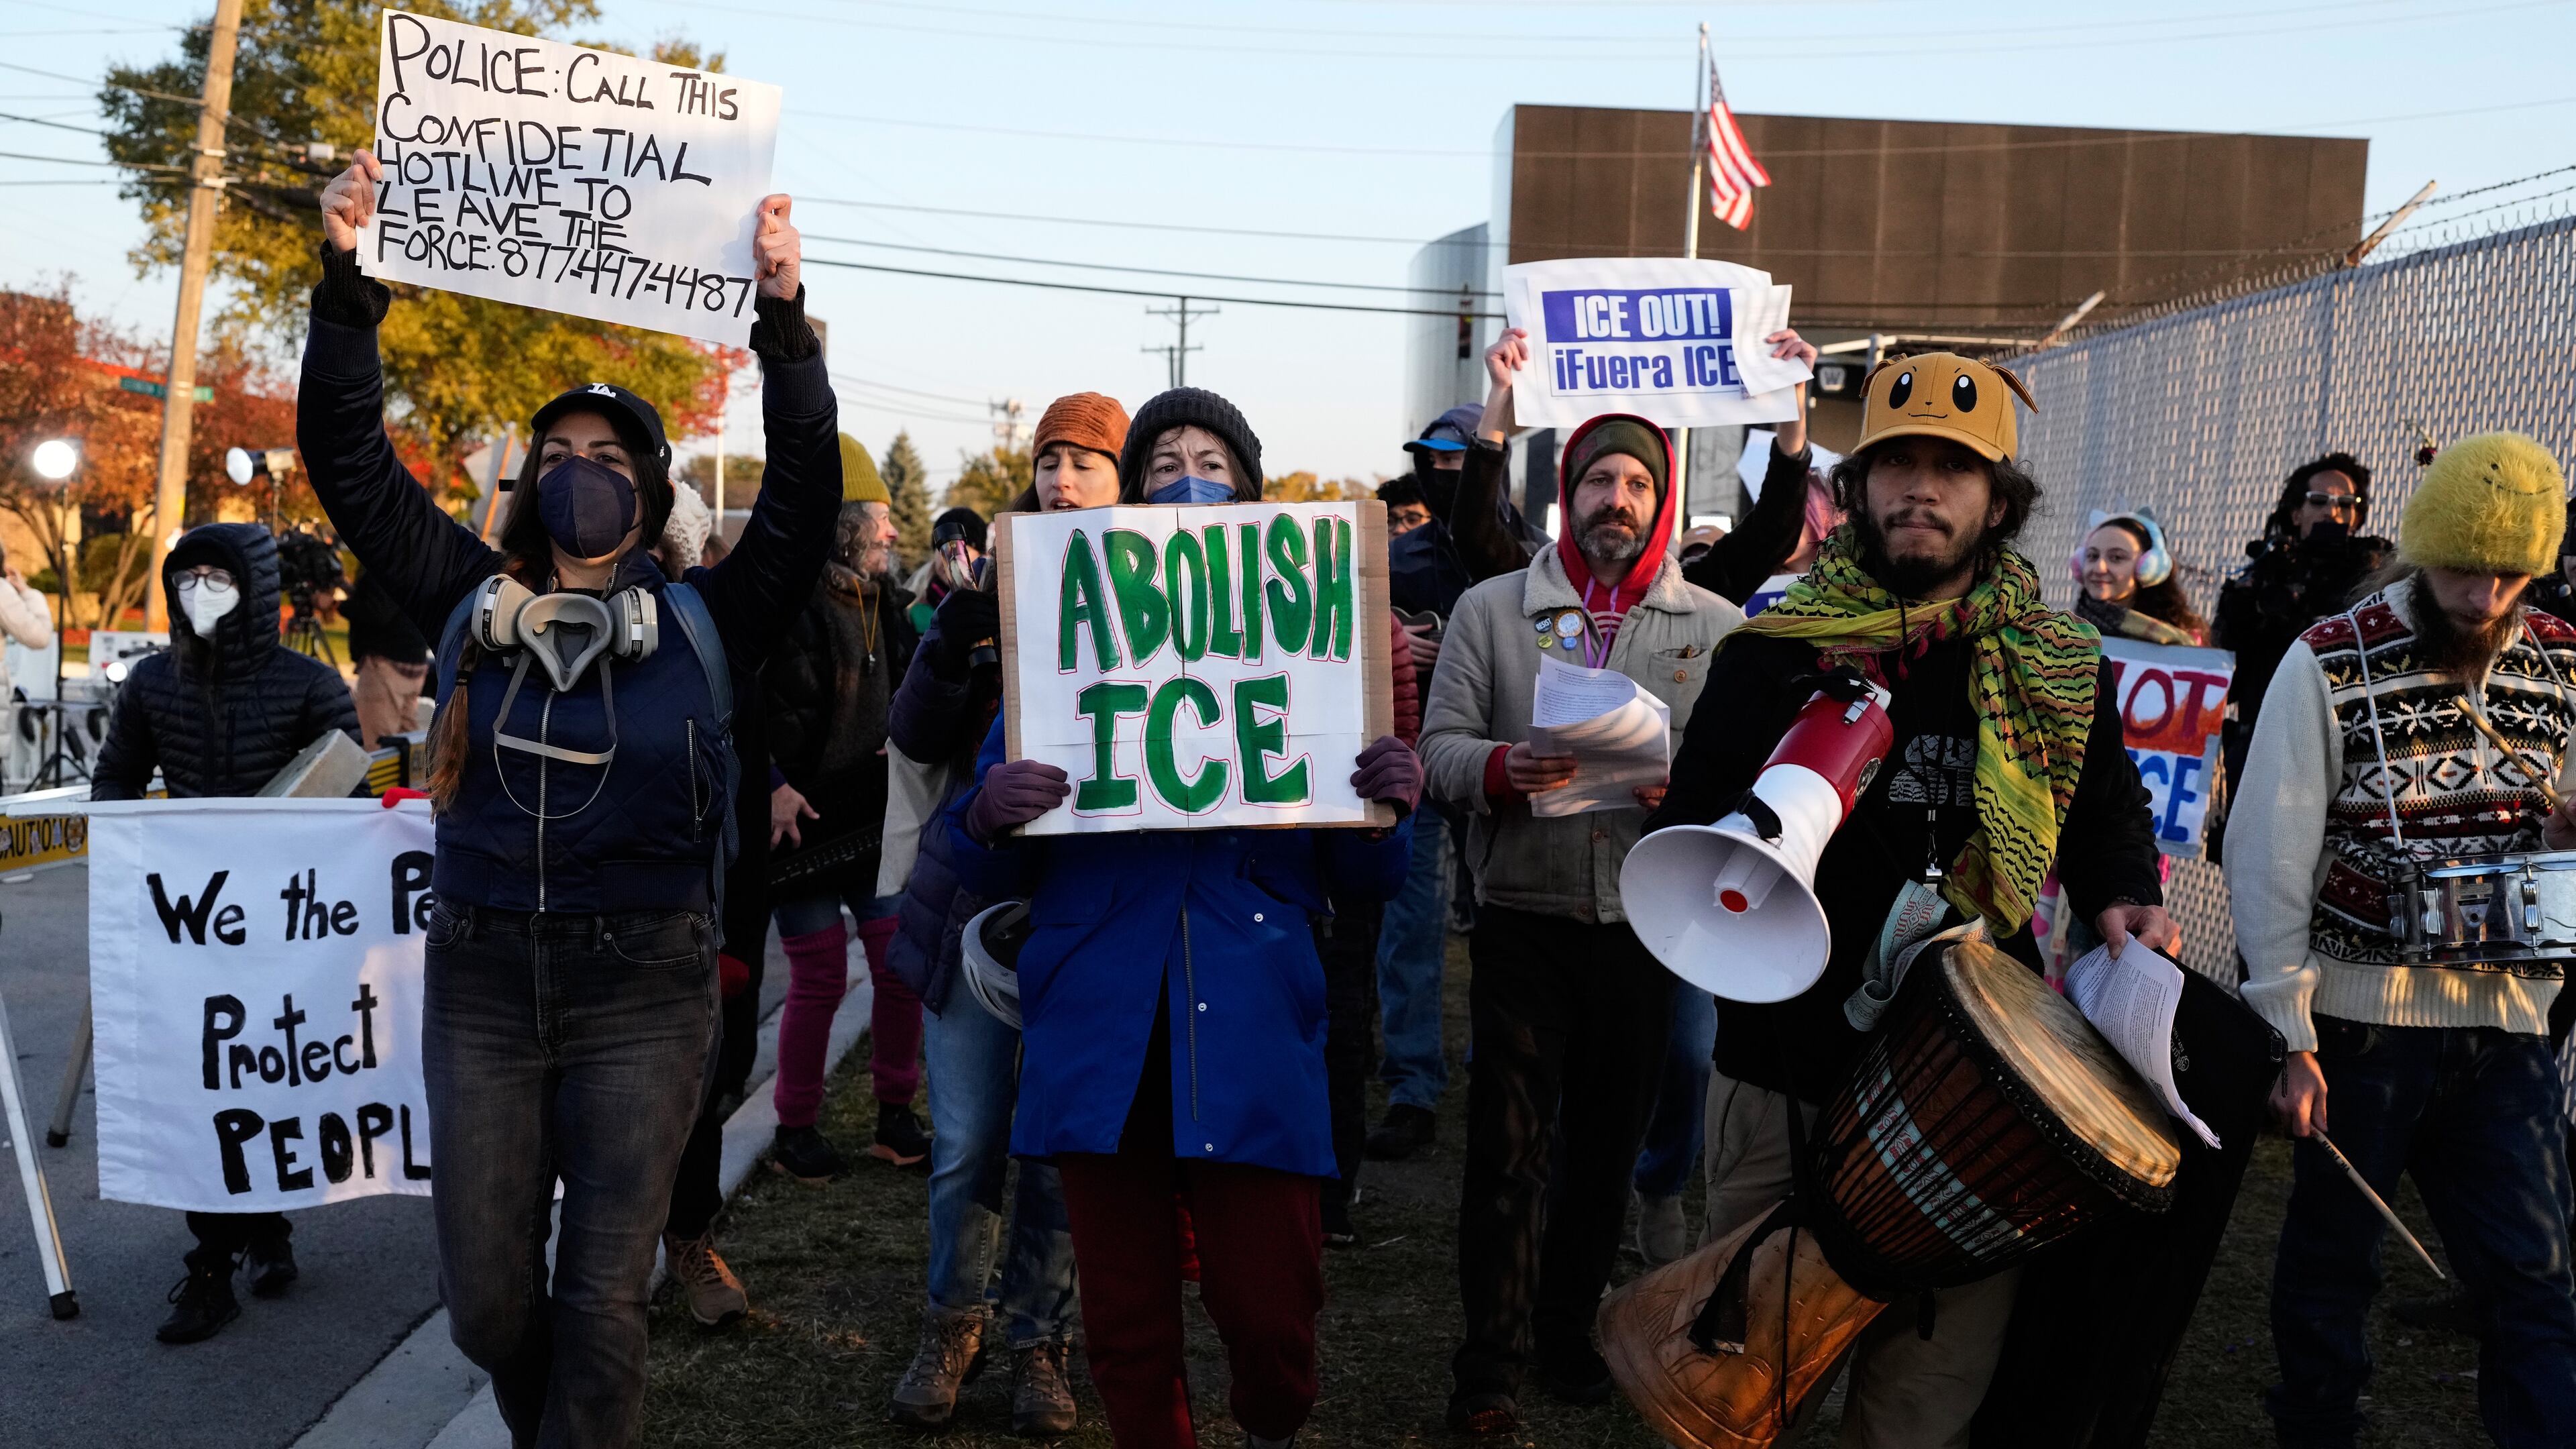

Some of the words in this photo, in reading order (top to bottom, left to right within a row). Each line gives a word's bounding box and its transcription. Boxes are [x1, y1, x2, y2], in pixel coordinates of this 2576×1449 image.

[388, 13, 561, 98] POLICE:
[567, 53, 654, 110] CALL
[670, 71, 739, 121] THIS
[376, 180, 543, 239] LEAVE
[559, 209, 633, 255] THE
[377, 138, 561, 207] HOTLINE
[574, 177, 632, 221] TO
[377, 220, 495, 271] FORCE:
[497, 237, 753, 319] 877-447-4487
[1574, 295, 1631, 339] ICE
[1639, 292, 1722, 338] OUT!
[1684, 344, 1744, 386] ICE
[1059, 513, 1354, 674] ABOLISH
[1535, 617, 1552, 631] RESIST
[2111, 660, 2229, 739] OT
[1071, 671, 1313, 817] ICE
[2125, 749, 2202, 843] CE
[0, 817, 62, 859] AUTIO
[146, 870, 246, 945] We
[280, 868, 359, 941] the
[202, 983, 378, 1089] Protect
[213, 1102, 431, 1195] PEOPL
